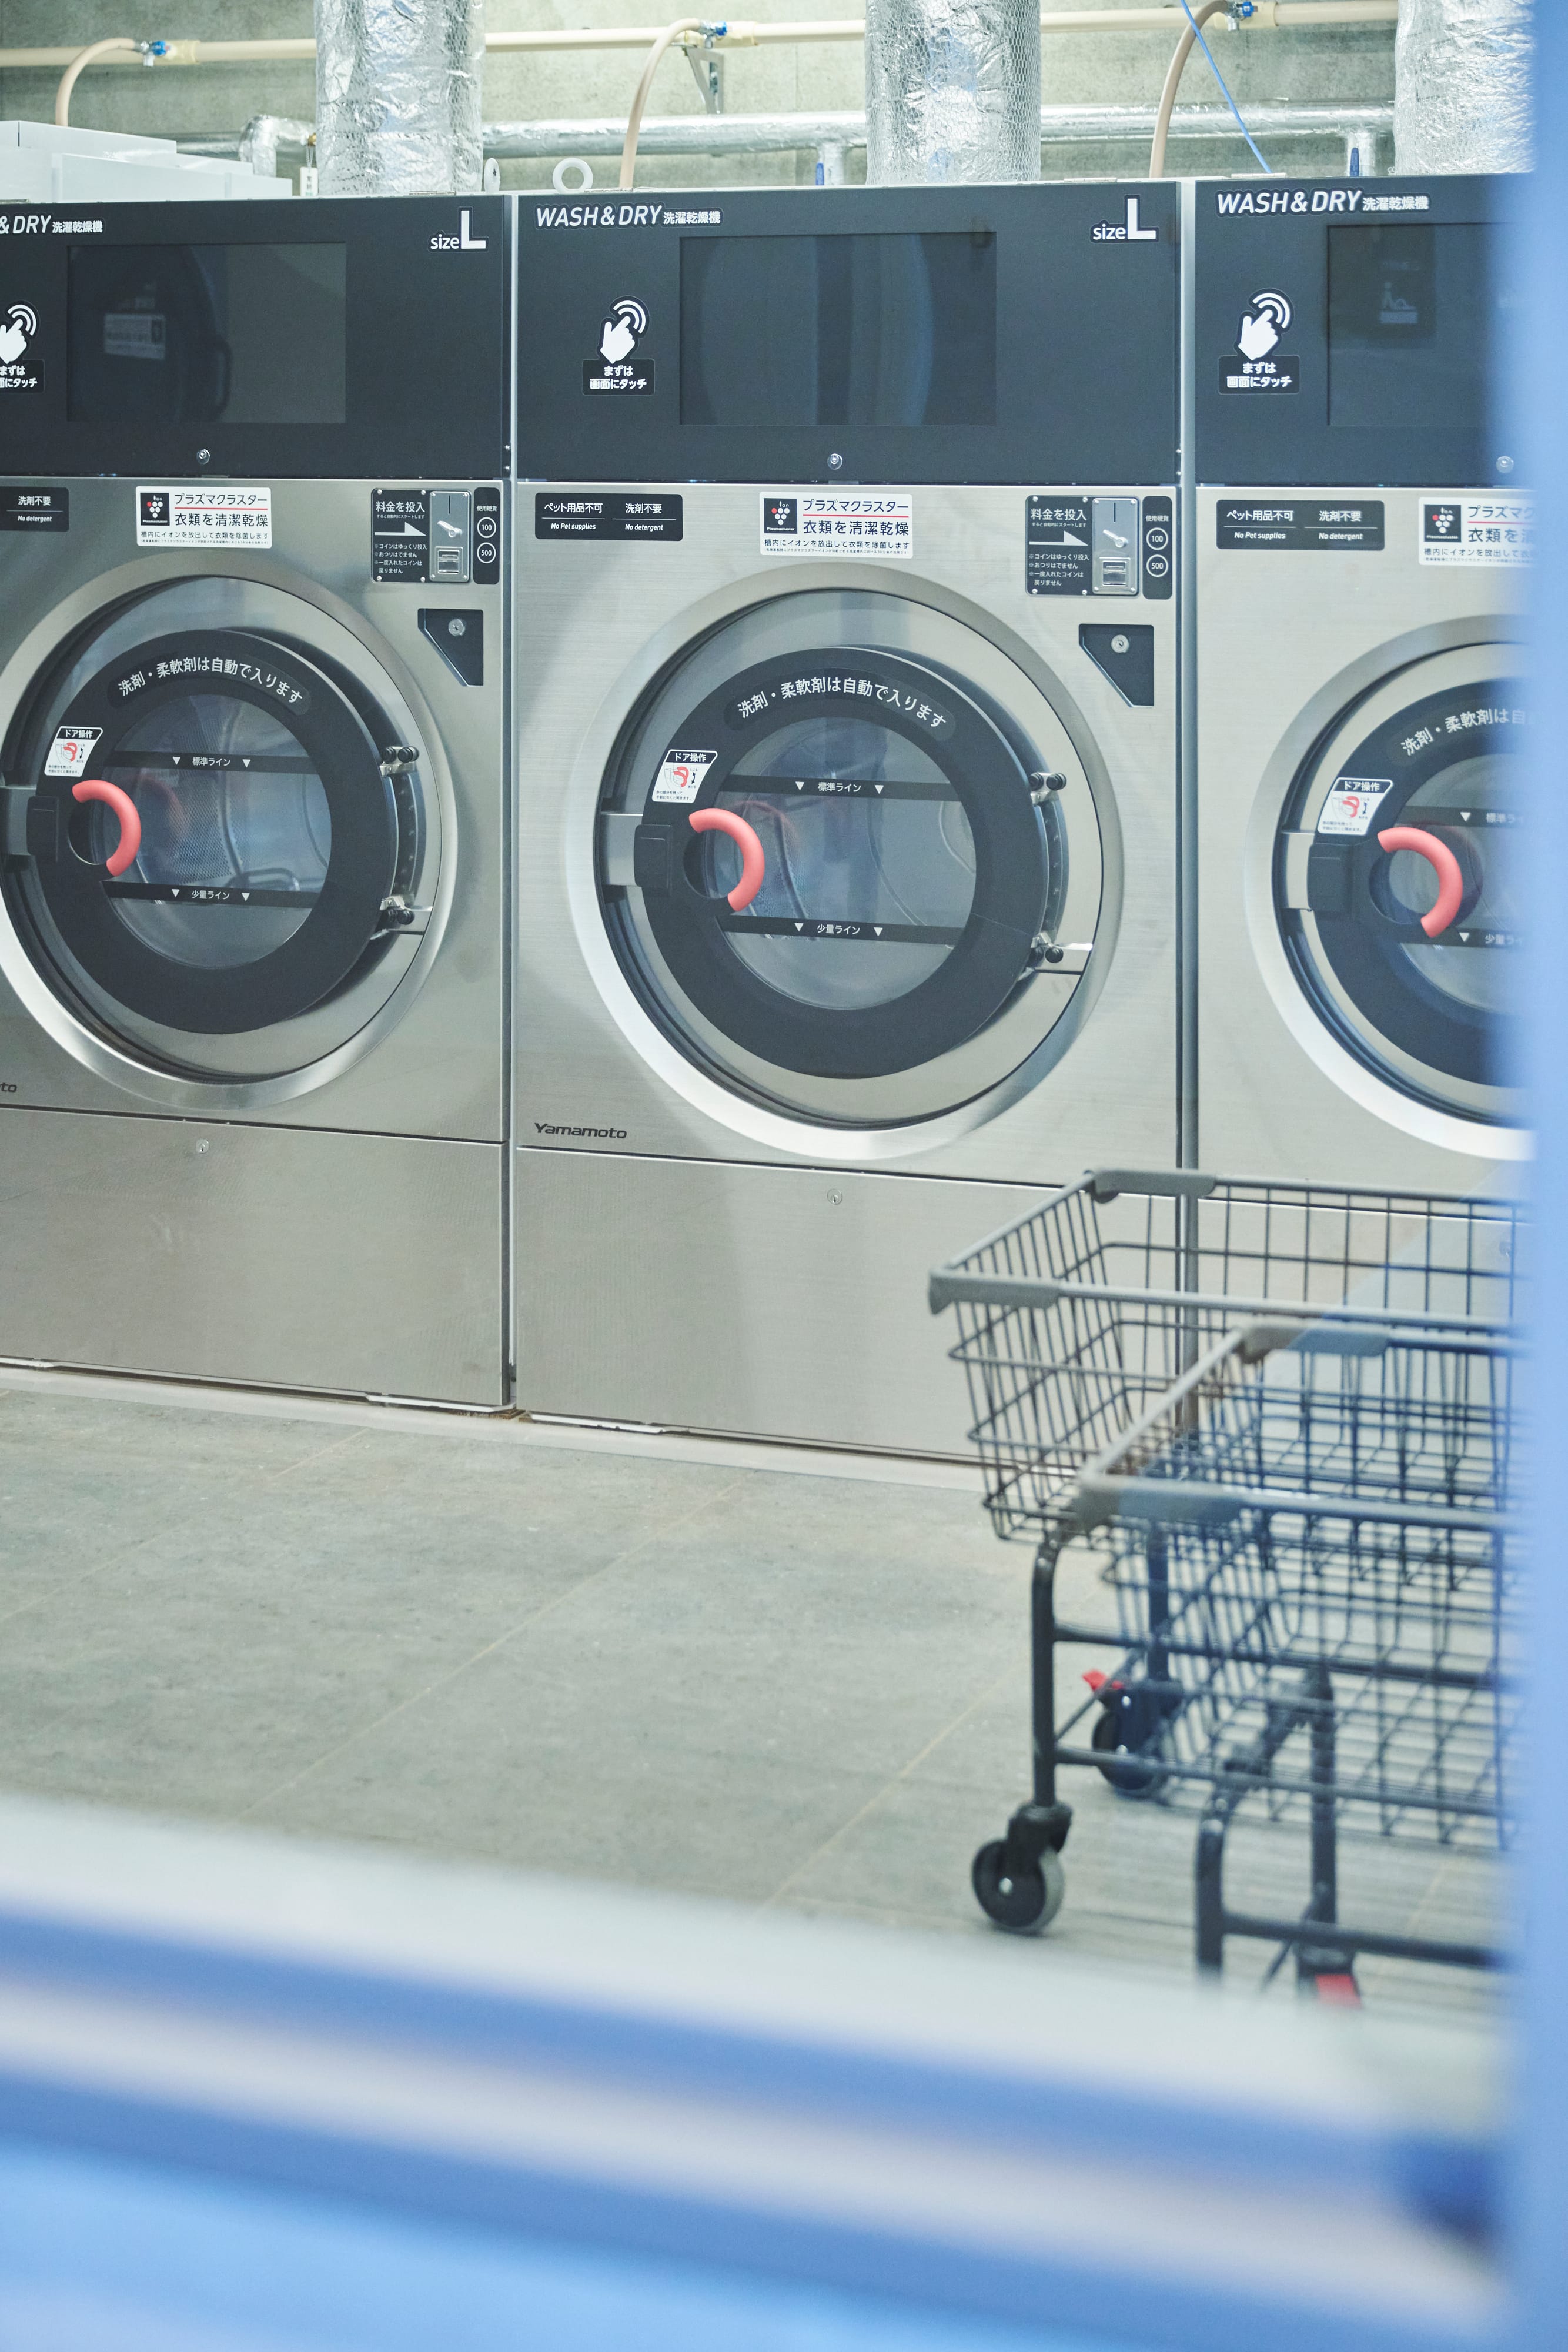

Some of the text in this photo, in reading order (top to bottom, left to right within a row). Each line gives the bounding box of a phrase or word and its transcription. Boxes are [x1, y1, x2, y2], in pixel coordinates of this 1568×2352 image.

[1362, 196, 1429, 211] 洗濯乾燥機
[663, 211, 721, 225] 洗濯乾燥機
[52, 220, 103, 233] 洗濯乾燥機
[0, 365, 25, 376] まずは
[604, 365, 633, 376] まずは
[1242, 362, 1277, 374] まずは
[589, 378, 647, 389] 画面にタッチ
[1226, 376, 1292, 388] 画面にタッチ
[18, 496, 51, 506] 洗剤不要
[174, 492, 268, 505] プラズマクラスター
[376, 500, 426, 513] 料金を投入
[544, 502, 603, 513] ペット用品不可
[625, 503, 663, 514] 洗剤不要
[803, 499, 909, 513] プラズマクラスター
[175, 513, 269, 527] 衣類を清潔乾燥
[1030, 508, 1087, 521] 料金を投入
[1226, 509, 1294, 522] ペット用品不可
[1319, 510, 1362, 522] 洗剤不要
[571, 523, 596, 531] supplies
[634, 524, 664, 532] detergent
[803, 520, 910, 536] 衣類を清潔乾燥
[1257, 532, 1286, 540] supplies
[1329, 533, 1363, 542] detergent
[764, 539, 910, 549] 槽内にイオンを放出して衣類を除菌します
[118, 657, 303, 704] 洗剤・柔軟剤は自動で入ります
[737, 676, 947, 729] 洗剤・柔軟剤は自動で入ります
[65, 729, 93, 739] ドア操作
[192, 756, 231, 767] 標準ライン
[675, 752, 707, 763] ドア操作
[818, 781, 861, 793] 標準ライン
[1344, 781, 1380, 792] ドア操作
[191, 889, 230, 900] 少量ライン
[817, 924, 861, 936] 少量ライン
[534, 1122, 627, 1139] Yamamoto
